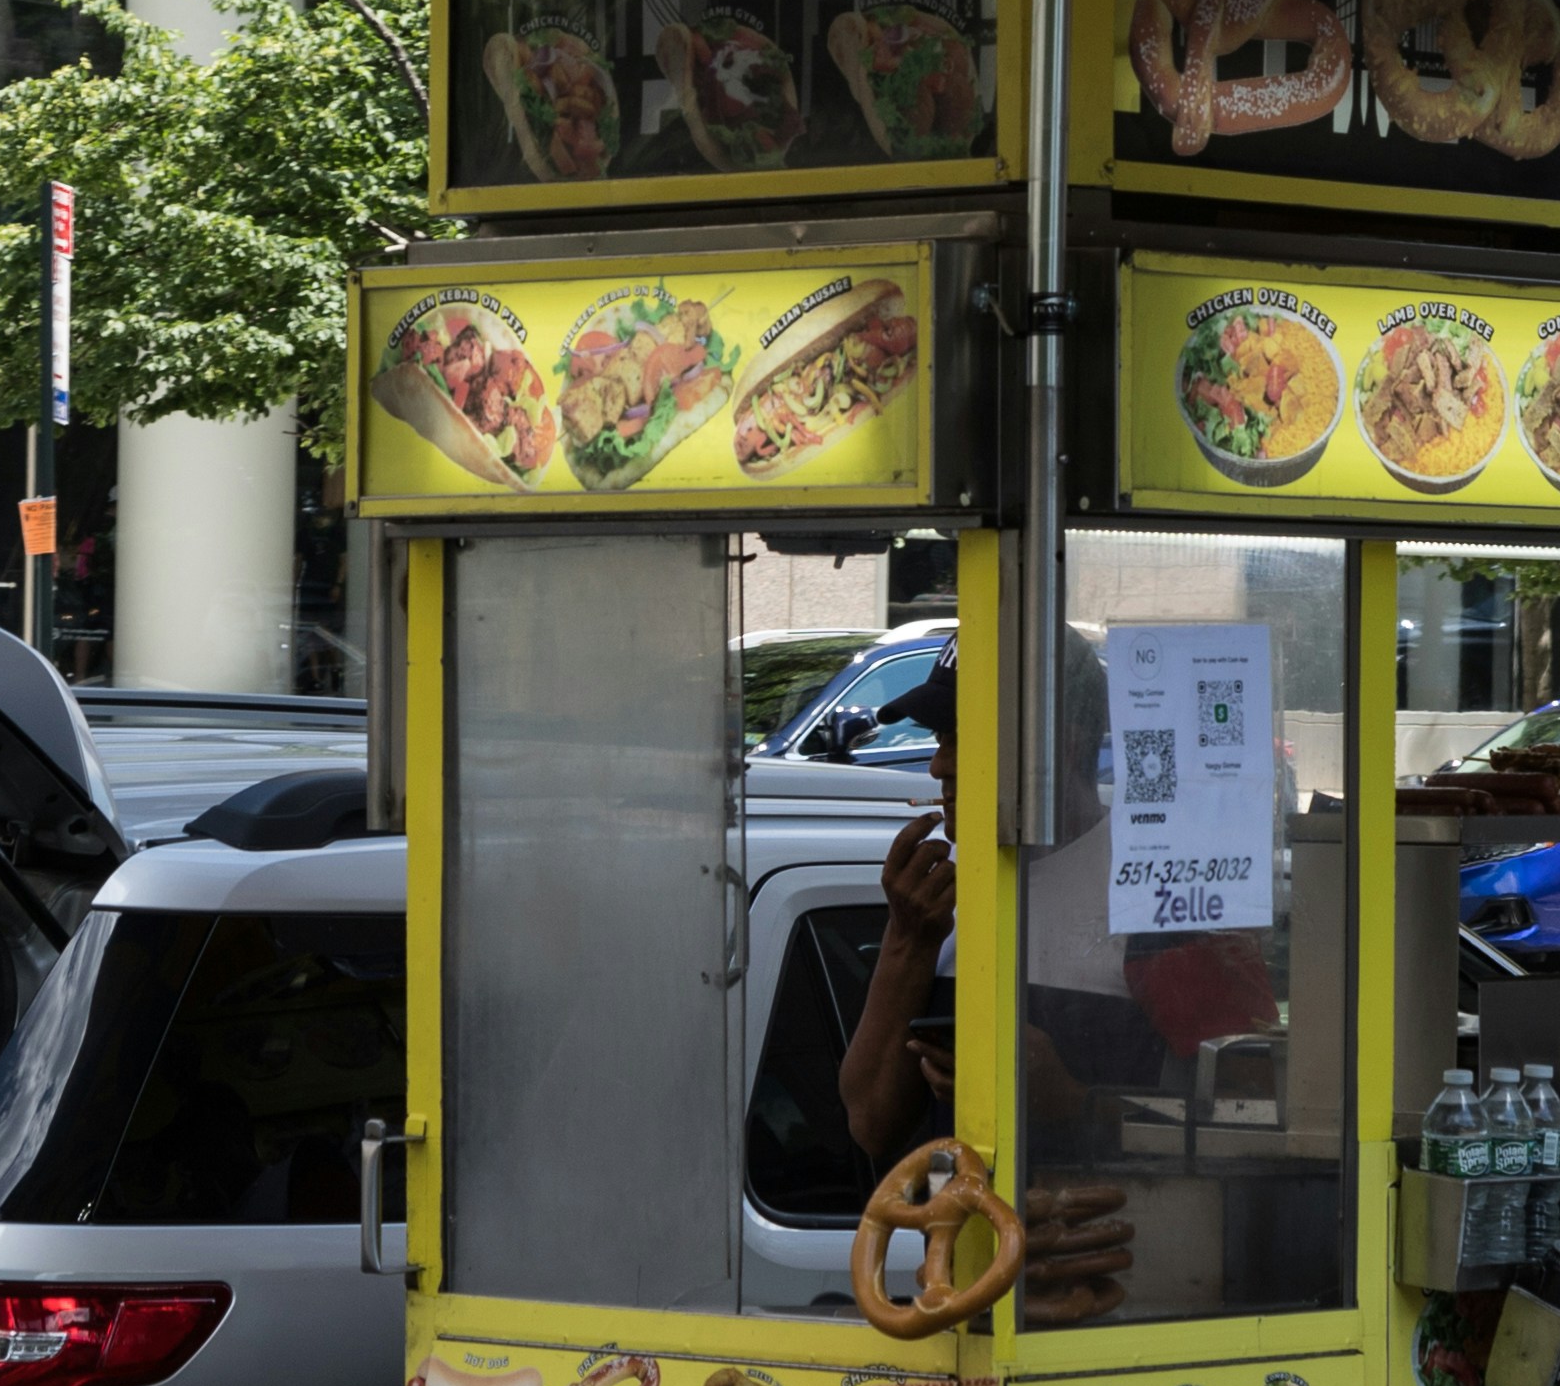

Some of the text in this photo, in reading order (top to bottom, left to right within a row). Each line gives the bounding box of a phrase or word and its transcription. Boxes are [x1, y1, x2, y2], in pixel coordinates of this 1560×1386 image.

[388, 288, 528, 348] CHICKEN KEBAB ON PITA
[760, 277, 852, 349] ITALIAN SAUSAGE
[1187, 289, 1337, 336] CHICKEN OVER RICE
[1378, 303, 1494, 340] LAMB OVER RICE
[1136, 649, 1156, 665] NG
[1130, 813, 1166, 825] venmo
[1116, 857, 1251, 886] 551-325-8032
[1153, 884, 1224, 928] Zelle
[1458, 1143, 1488, 1160] Poland
[1495, 1143, 1528, 1156] Poland
[1460, 1156, 1489, 1172] Spring
[1496, 1153, 1528, 1168] Spring
[465, 1353, 509, 1370] HOT DOG
